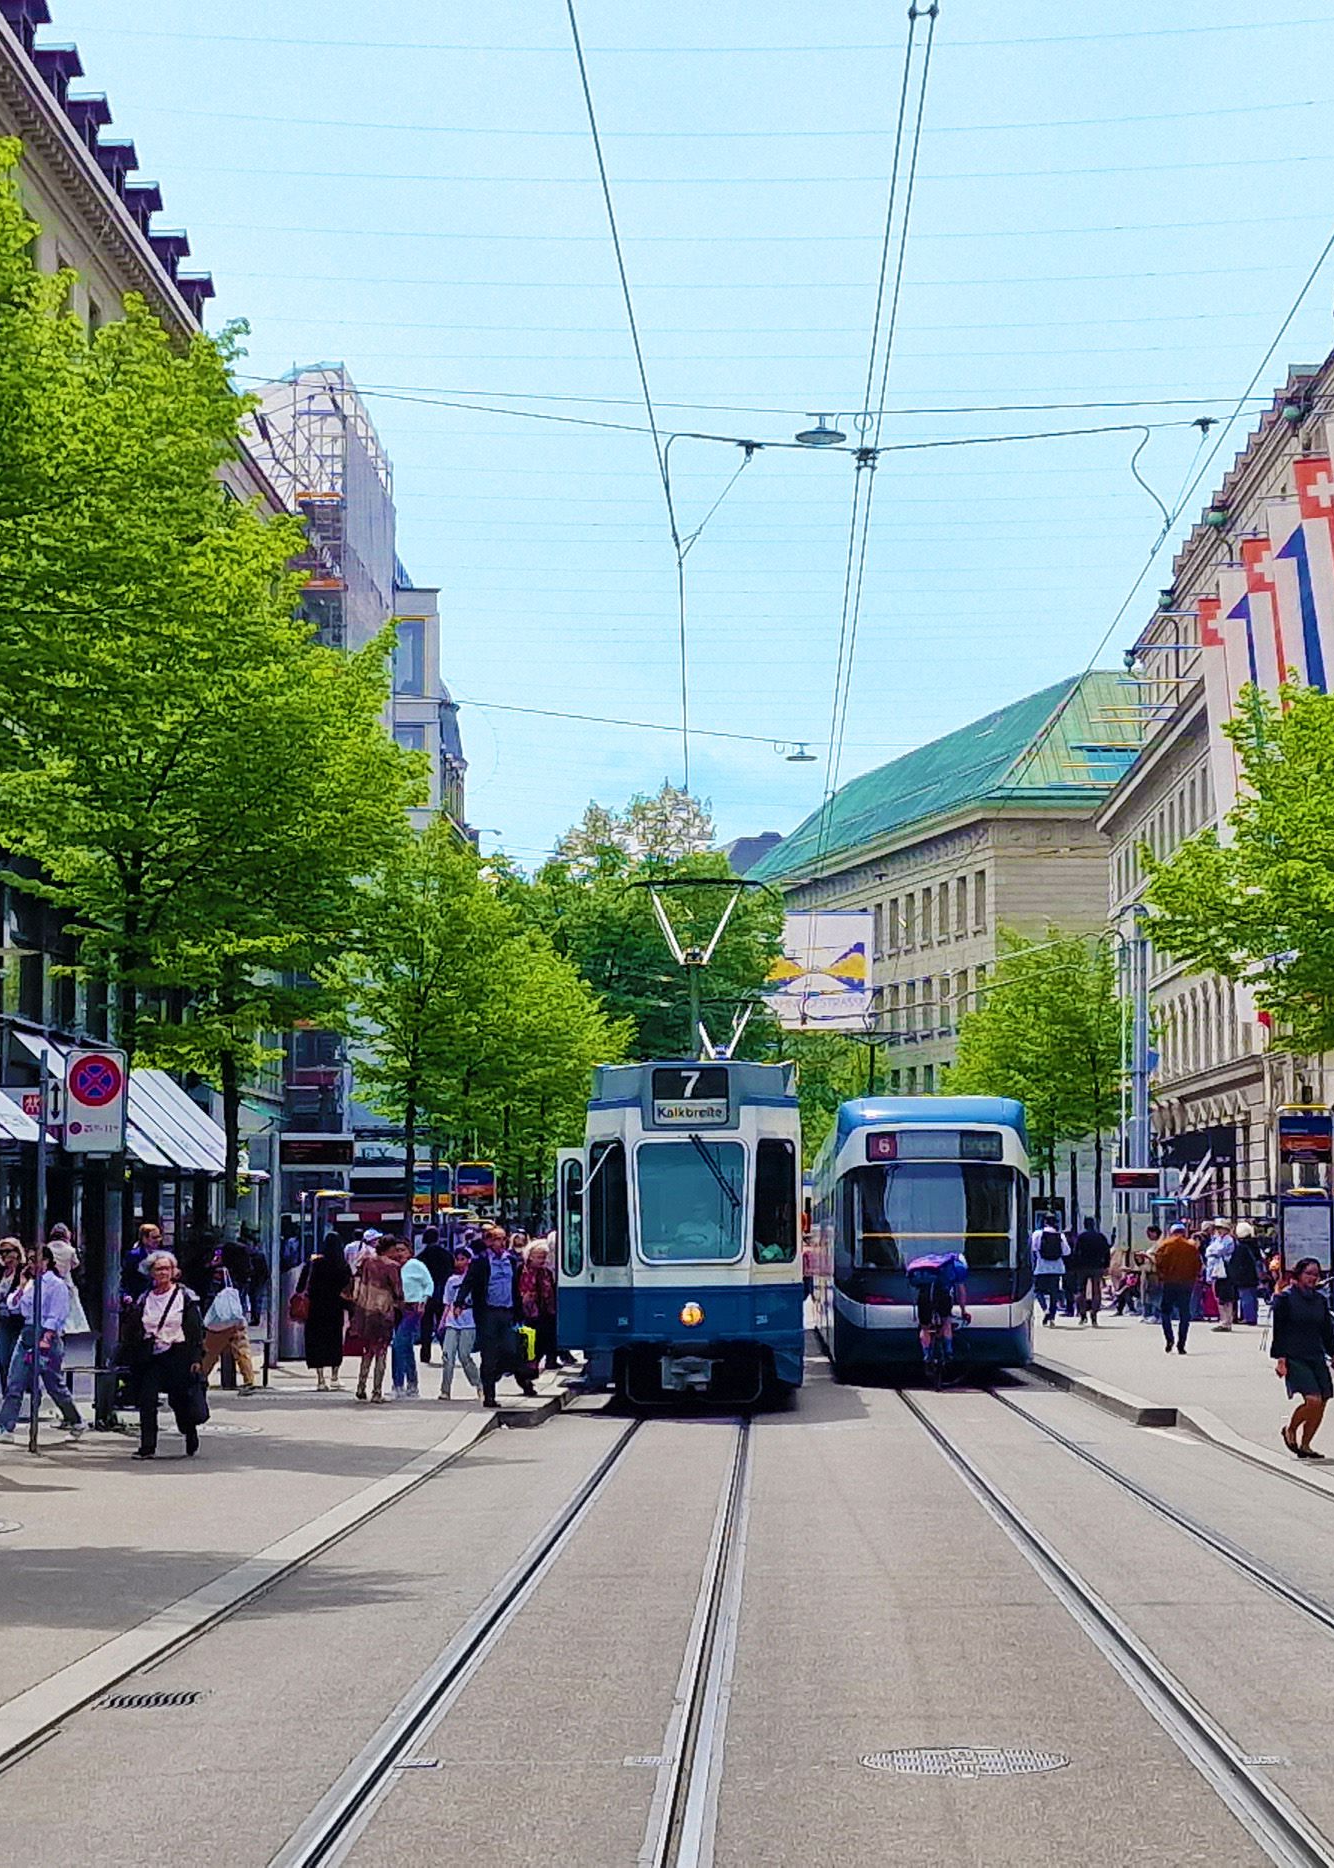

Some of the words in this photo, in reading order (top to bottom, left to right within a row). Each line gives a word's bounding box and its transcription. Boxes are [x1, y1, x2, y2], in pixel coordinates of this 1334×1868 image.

[680, 1070, 702, 1098] 7
[656, 1106, 723, 1119] Kalkbreite
[878, 1138, 891, 1153] 6
